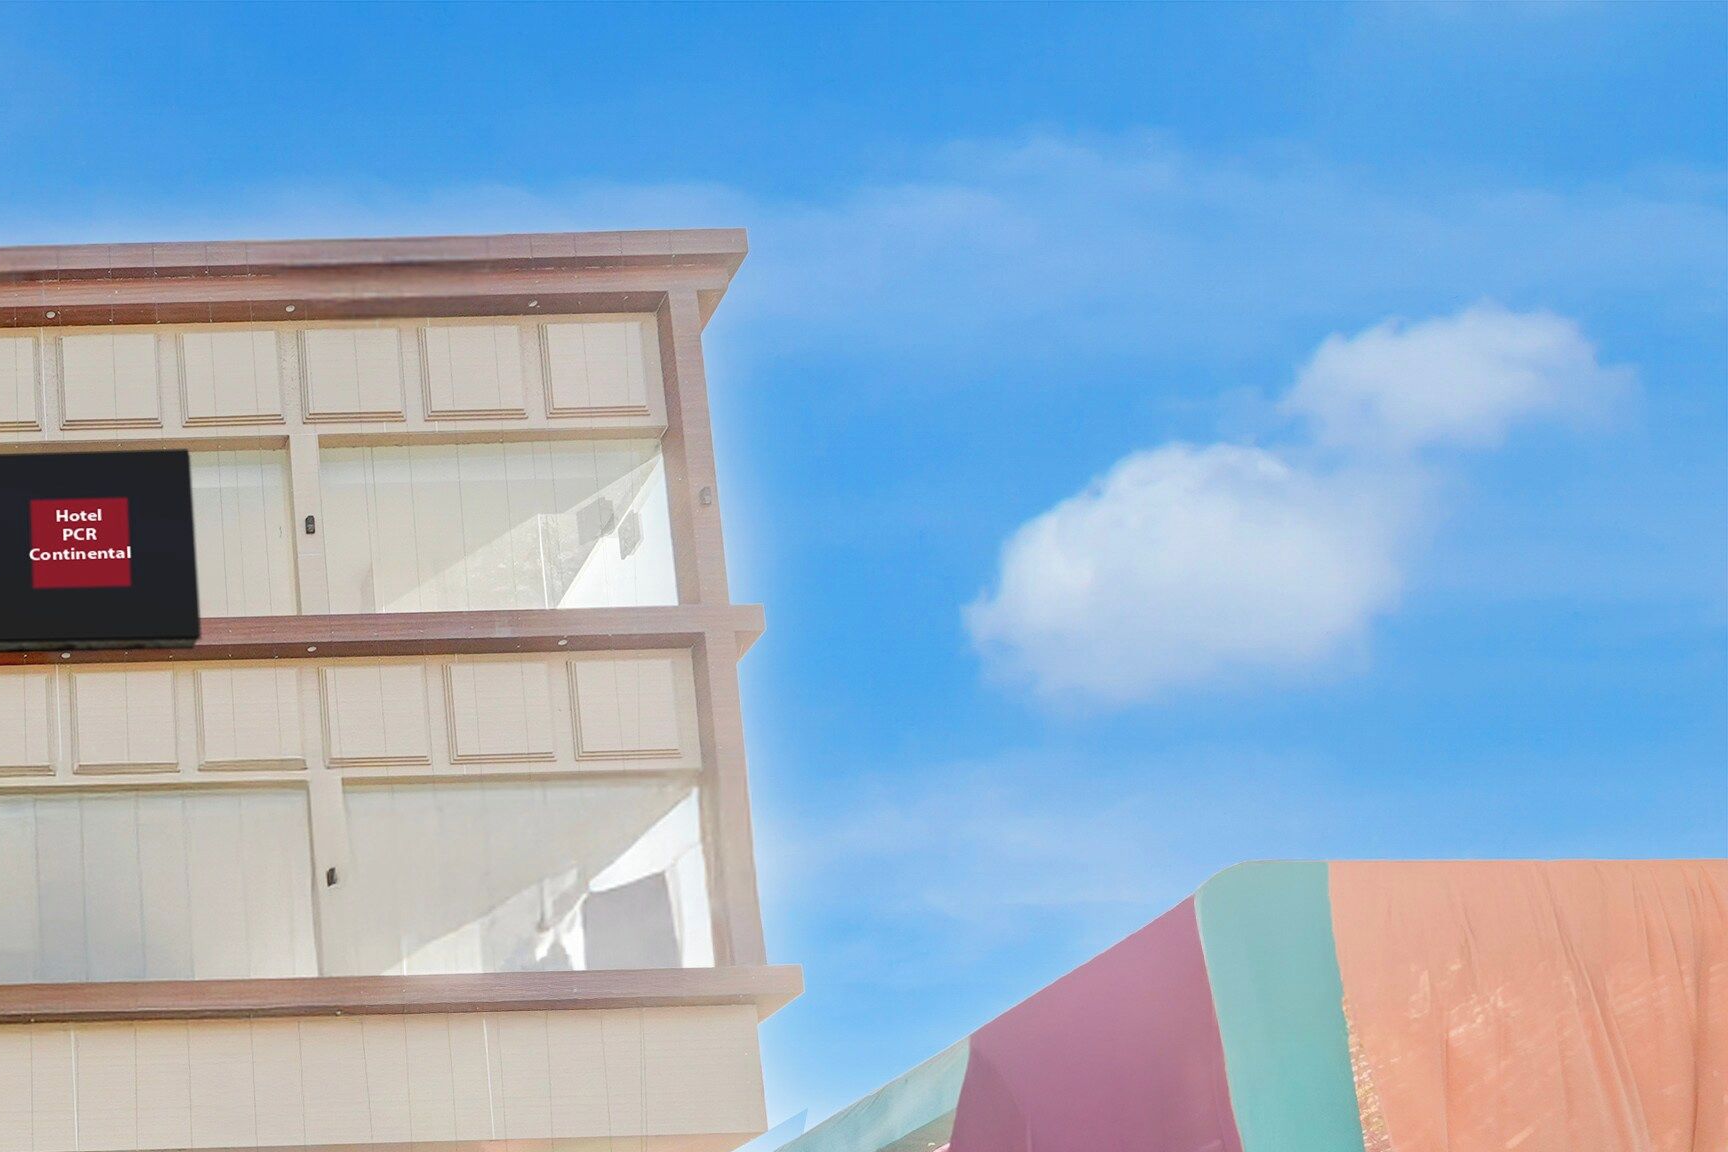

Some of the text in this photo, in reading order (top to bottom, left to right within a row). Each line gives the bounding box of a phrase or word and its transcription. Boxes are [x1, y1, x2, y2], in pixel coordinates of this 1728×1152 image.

[55, 508, 103, 523] Hotel
[62, 527, 98, 541] PCR
[28, 545, 132, 561] Continental
